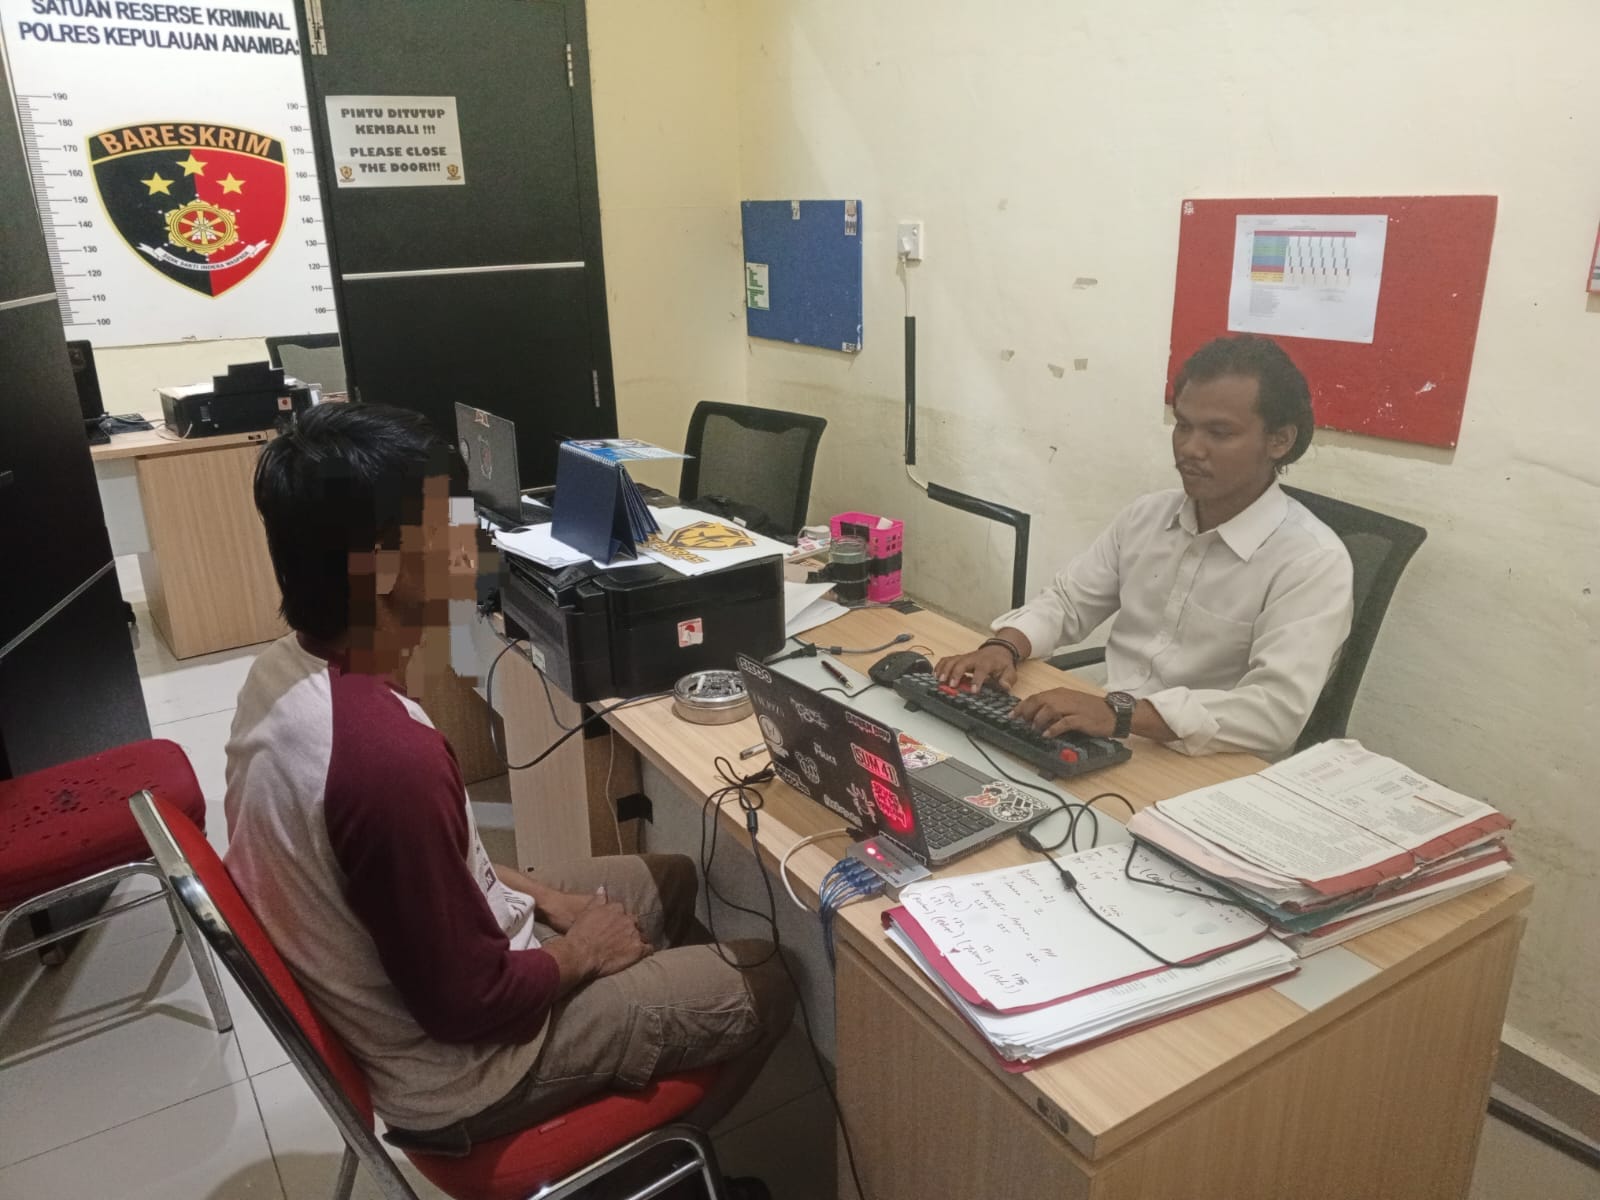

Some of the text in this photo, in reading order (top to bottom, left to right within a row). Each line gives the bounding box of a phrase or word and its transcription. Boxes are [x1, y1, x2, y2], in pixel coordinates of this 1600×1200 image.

[32, 0, 291, 31] SATUAN RESERSE KRIMINAL
[18, 21, 101, 45] POLRES
[103, 27, 219, 52] KEPULAUAN
[52, 93, 68, 101] 190
[341, 108, 445, 118] PINTU DITUTUP
[58, 119, 73, 127] 180
[355, 124, 436, 135] KEMBALI !!!
[97, 125, 272, 156] BARESKRIM
[62, 145, 78, 153] 170
[350, 146, 447, 157] PLEASE CLOSE
[359, 162, 441, 173] THE DOOR!!!
[73, 196, 88, 204] 150
[87, 269, 102, 277] 120
[92, 294, 106, 302] 110
[96, 318, 111, 326] 100
[855, 748, 877, 774] SUM
[878, 761, 894, 783] 41
